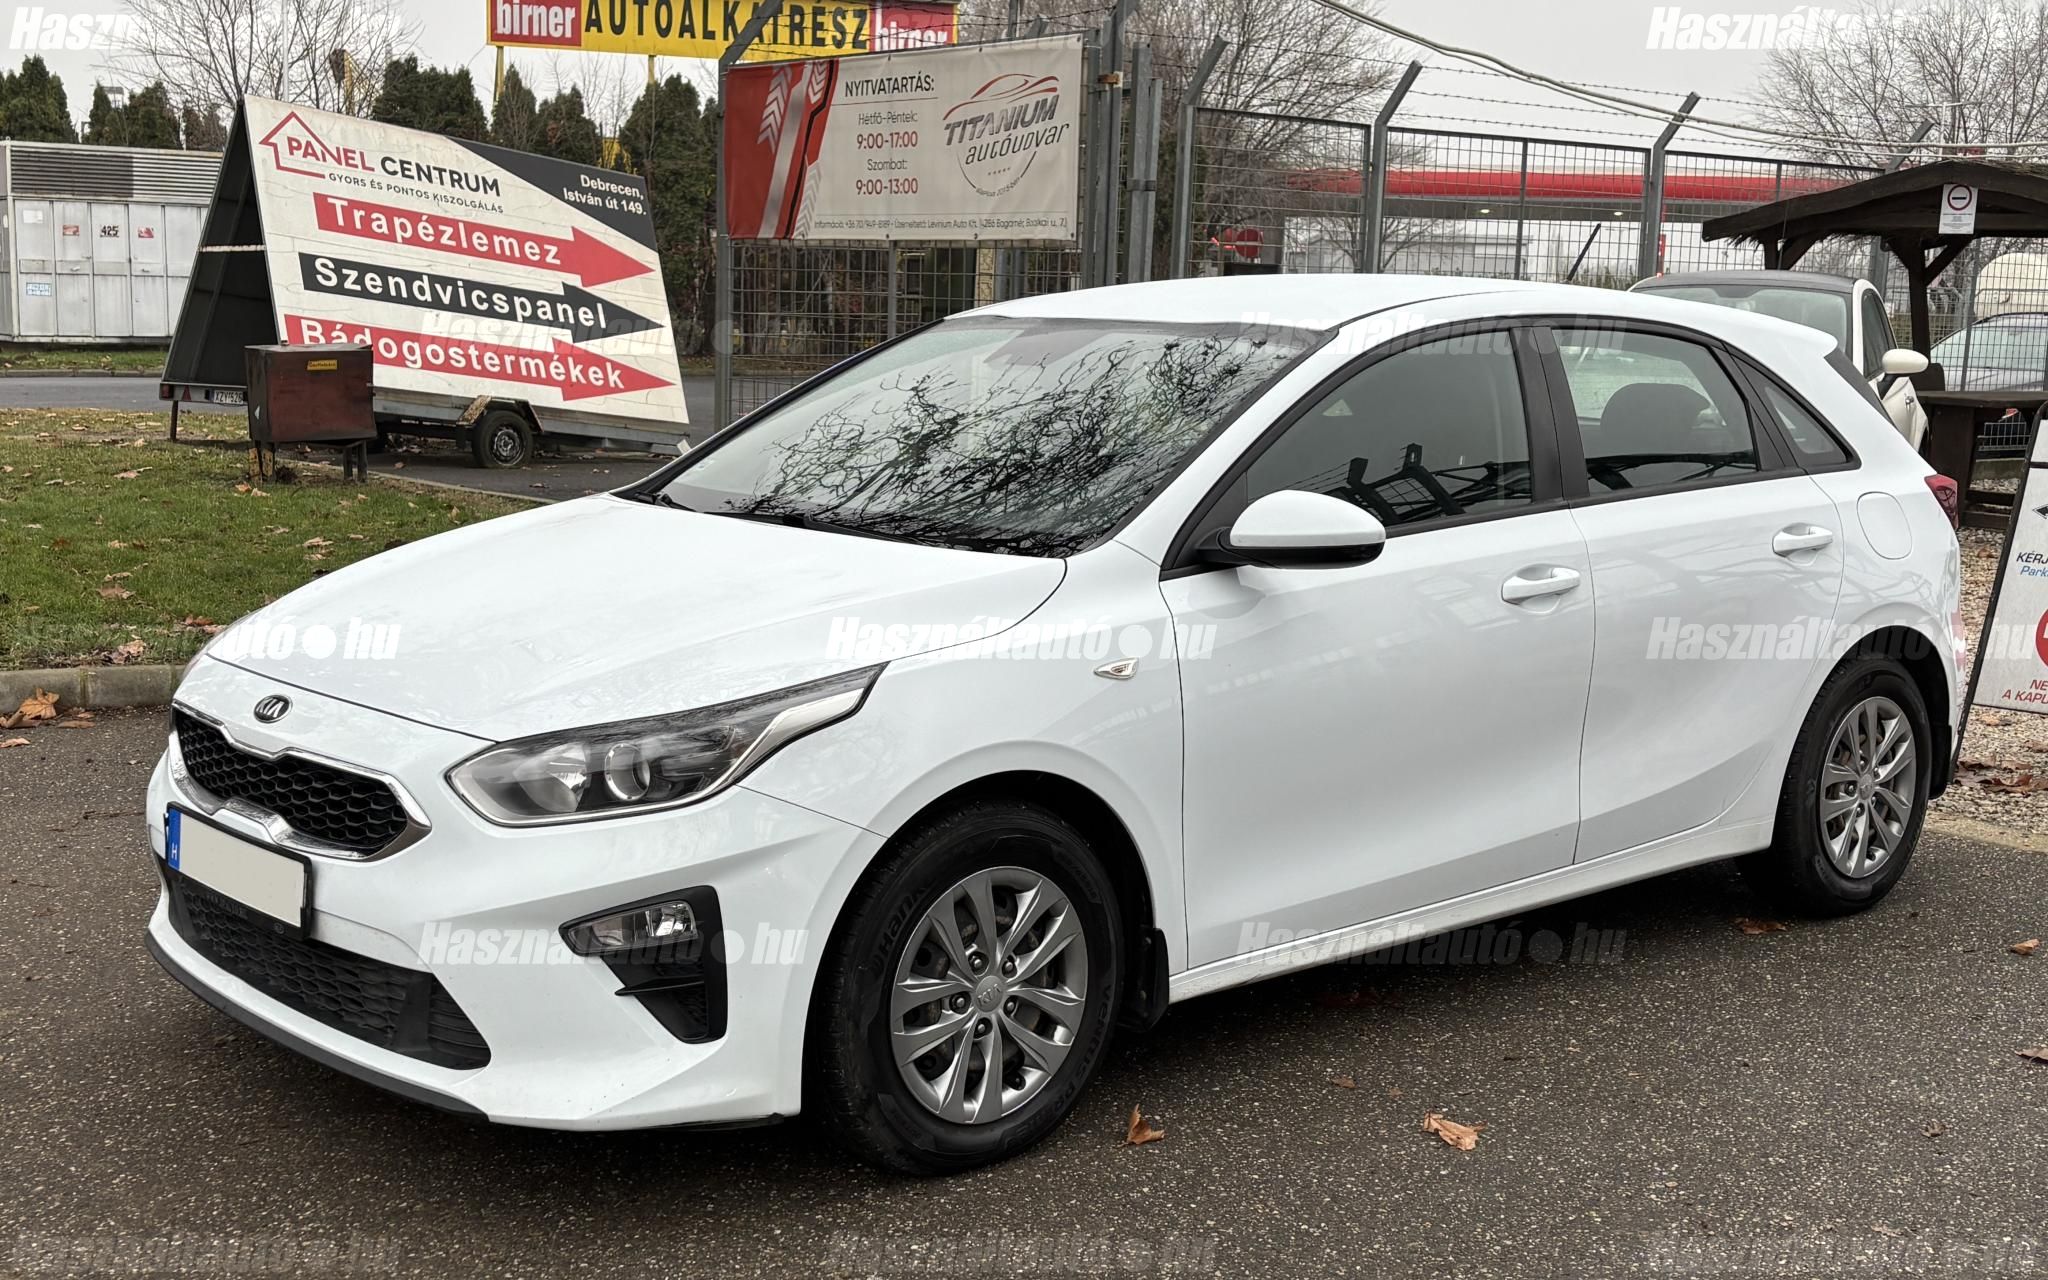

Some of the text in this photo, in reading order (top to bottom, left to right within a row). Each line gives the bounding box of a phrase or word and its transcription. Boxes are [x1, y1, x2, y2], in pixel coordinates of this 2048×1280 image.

[496, 0, 576, 38] birner
[845, 72, 935, 97] NYITVATARTÁS:
[944, 94, 1059, 146] TITANIUM
[856, 131, 918, 150] 9:00-17:00
[287, 136, 501, 196] PANEL CENTRUM
[329, 173, 504, 214] GYORS ÉS PONTOS KISZOLGÁLÁS
[580, 174, 644, 200] Debrecen,
[856, 177, 918, 195] 9:00-13:00
[563, 187, 647, 215] István út 149.
[101, 226, 119, 237] 425
[327, 198, 562, 266] Trapézlemez
[314, 257, 608, 329] Szendvicspanel
[300, 319, 625, 389] Bádogostermékek
[2020, 565, 2048, 577] Park
[2001, 689, 2012, 700] A
[256, 699, 286, 718] KIA
